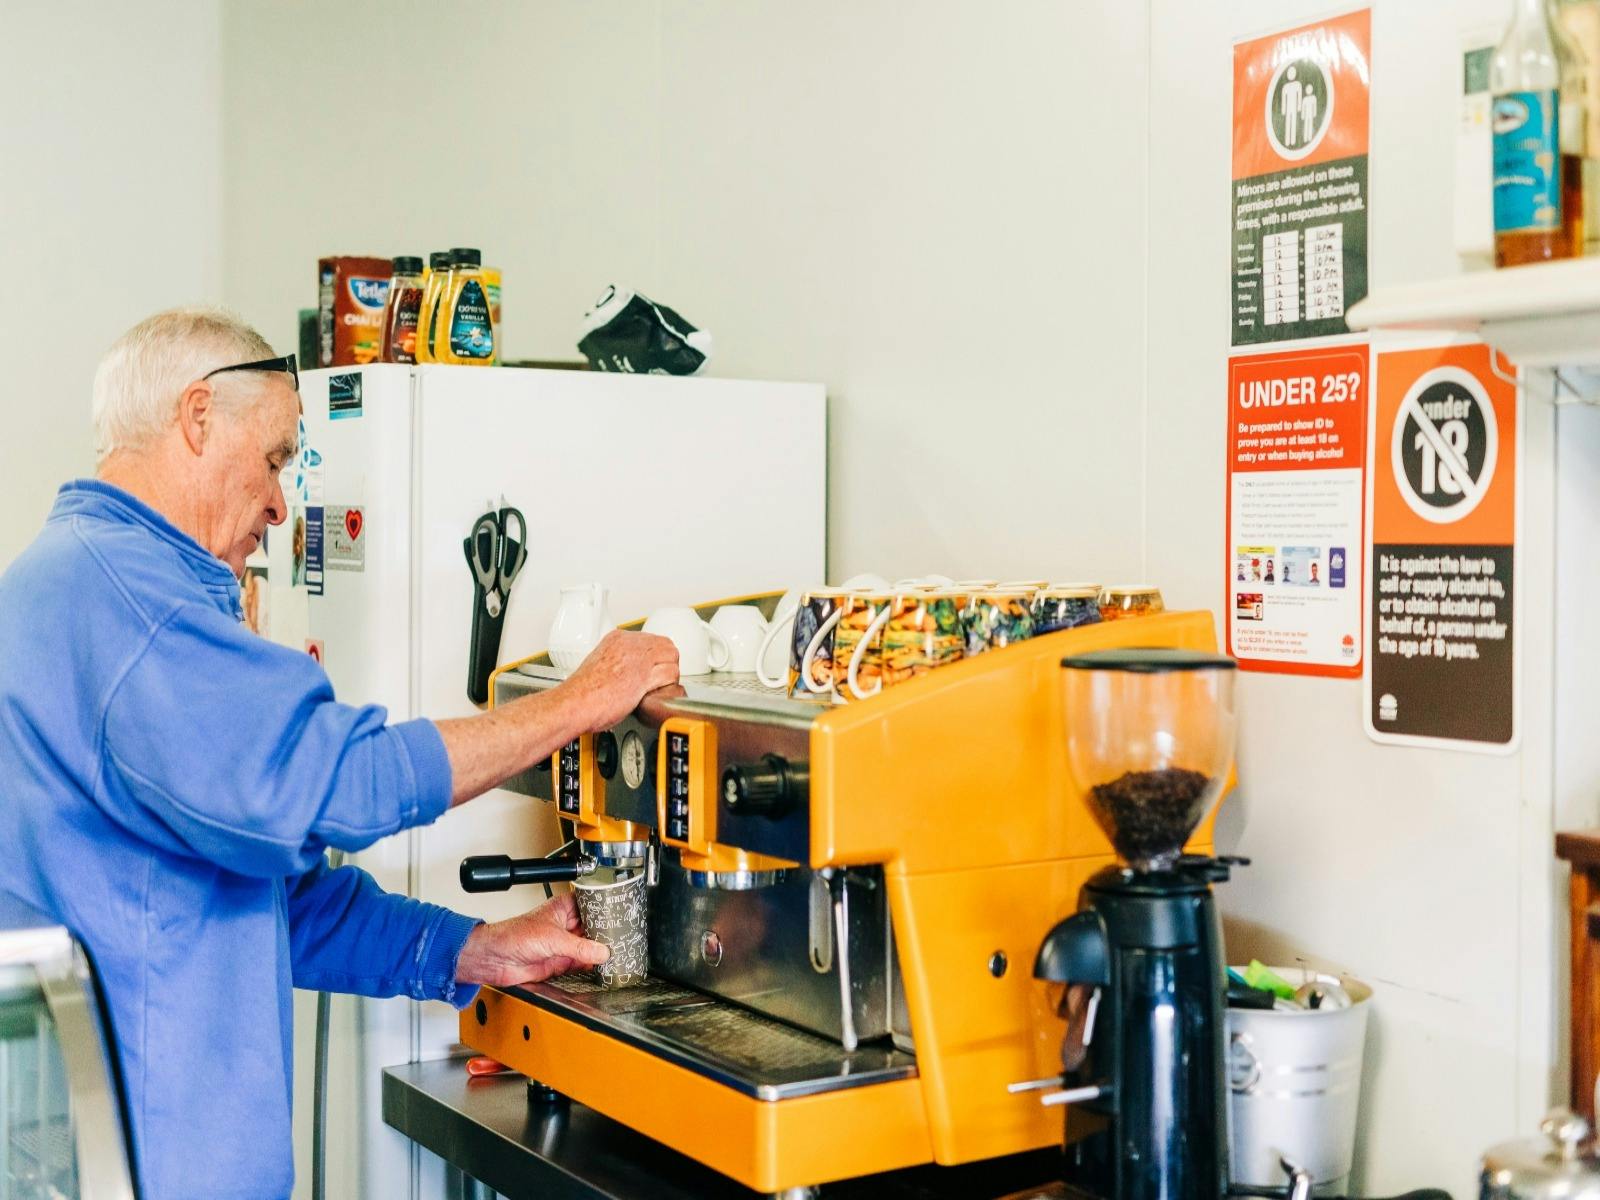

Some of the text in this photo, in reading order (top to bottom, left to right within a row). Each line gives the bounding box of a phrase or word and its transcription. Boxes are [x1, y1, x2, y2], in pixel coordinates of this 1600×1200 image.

[1237, 166, 1354, 197] Minors are allowed on these
[1237, 182, 1360, 216] premises during the following
[1262, 212, 1280, 226] with
[1281, 213, 1287, 223] a
[1287, 202, 1339, 222] responsible
[1240, 372, 1361, 409] UNDER 25?
[1422, 394, 1472, 420] under
[1238, 418, 1334, 434] Be prepared to show ID to
[1238, 433, 1339, 449] prove you are at least 18 on
[1238, 447, 1344, 463] entry or when buying alcohol
[1414, 420, 1469, 495] 18
[1380, 554, 1495, 577] It is against the law to
[1380, 575, 1399, 593] sell
[1400, 579, 1412, 593] or
[1413, 575, 1448, 598] supply
[1448, 576, 1489, 595] alcohol
[1379, 596, 1496, 617] or to obtain alcohol on
[1380, 615, 1413, 633] behalf
[1437, 621, 1474, 639] person
[1475, 619, 1507, 639] under
[1379, 636, 1397, 653] the
[1399, 640, 1418, 658] age
[1420, 638, 1432, 655] of
